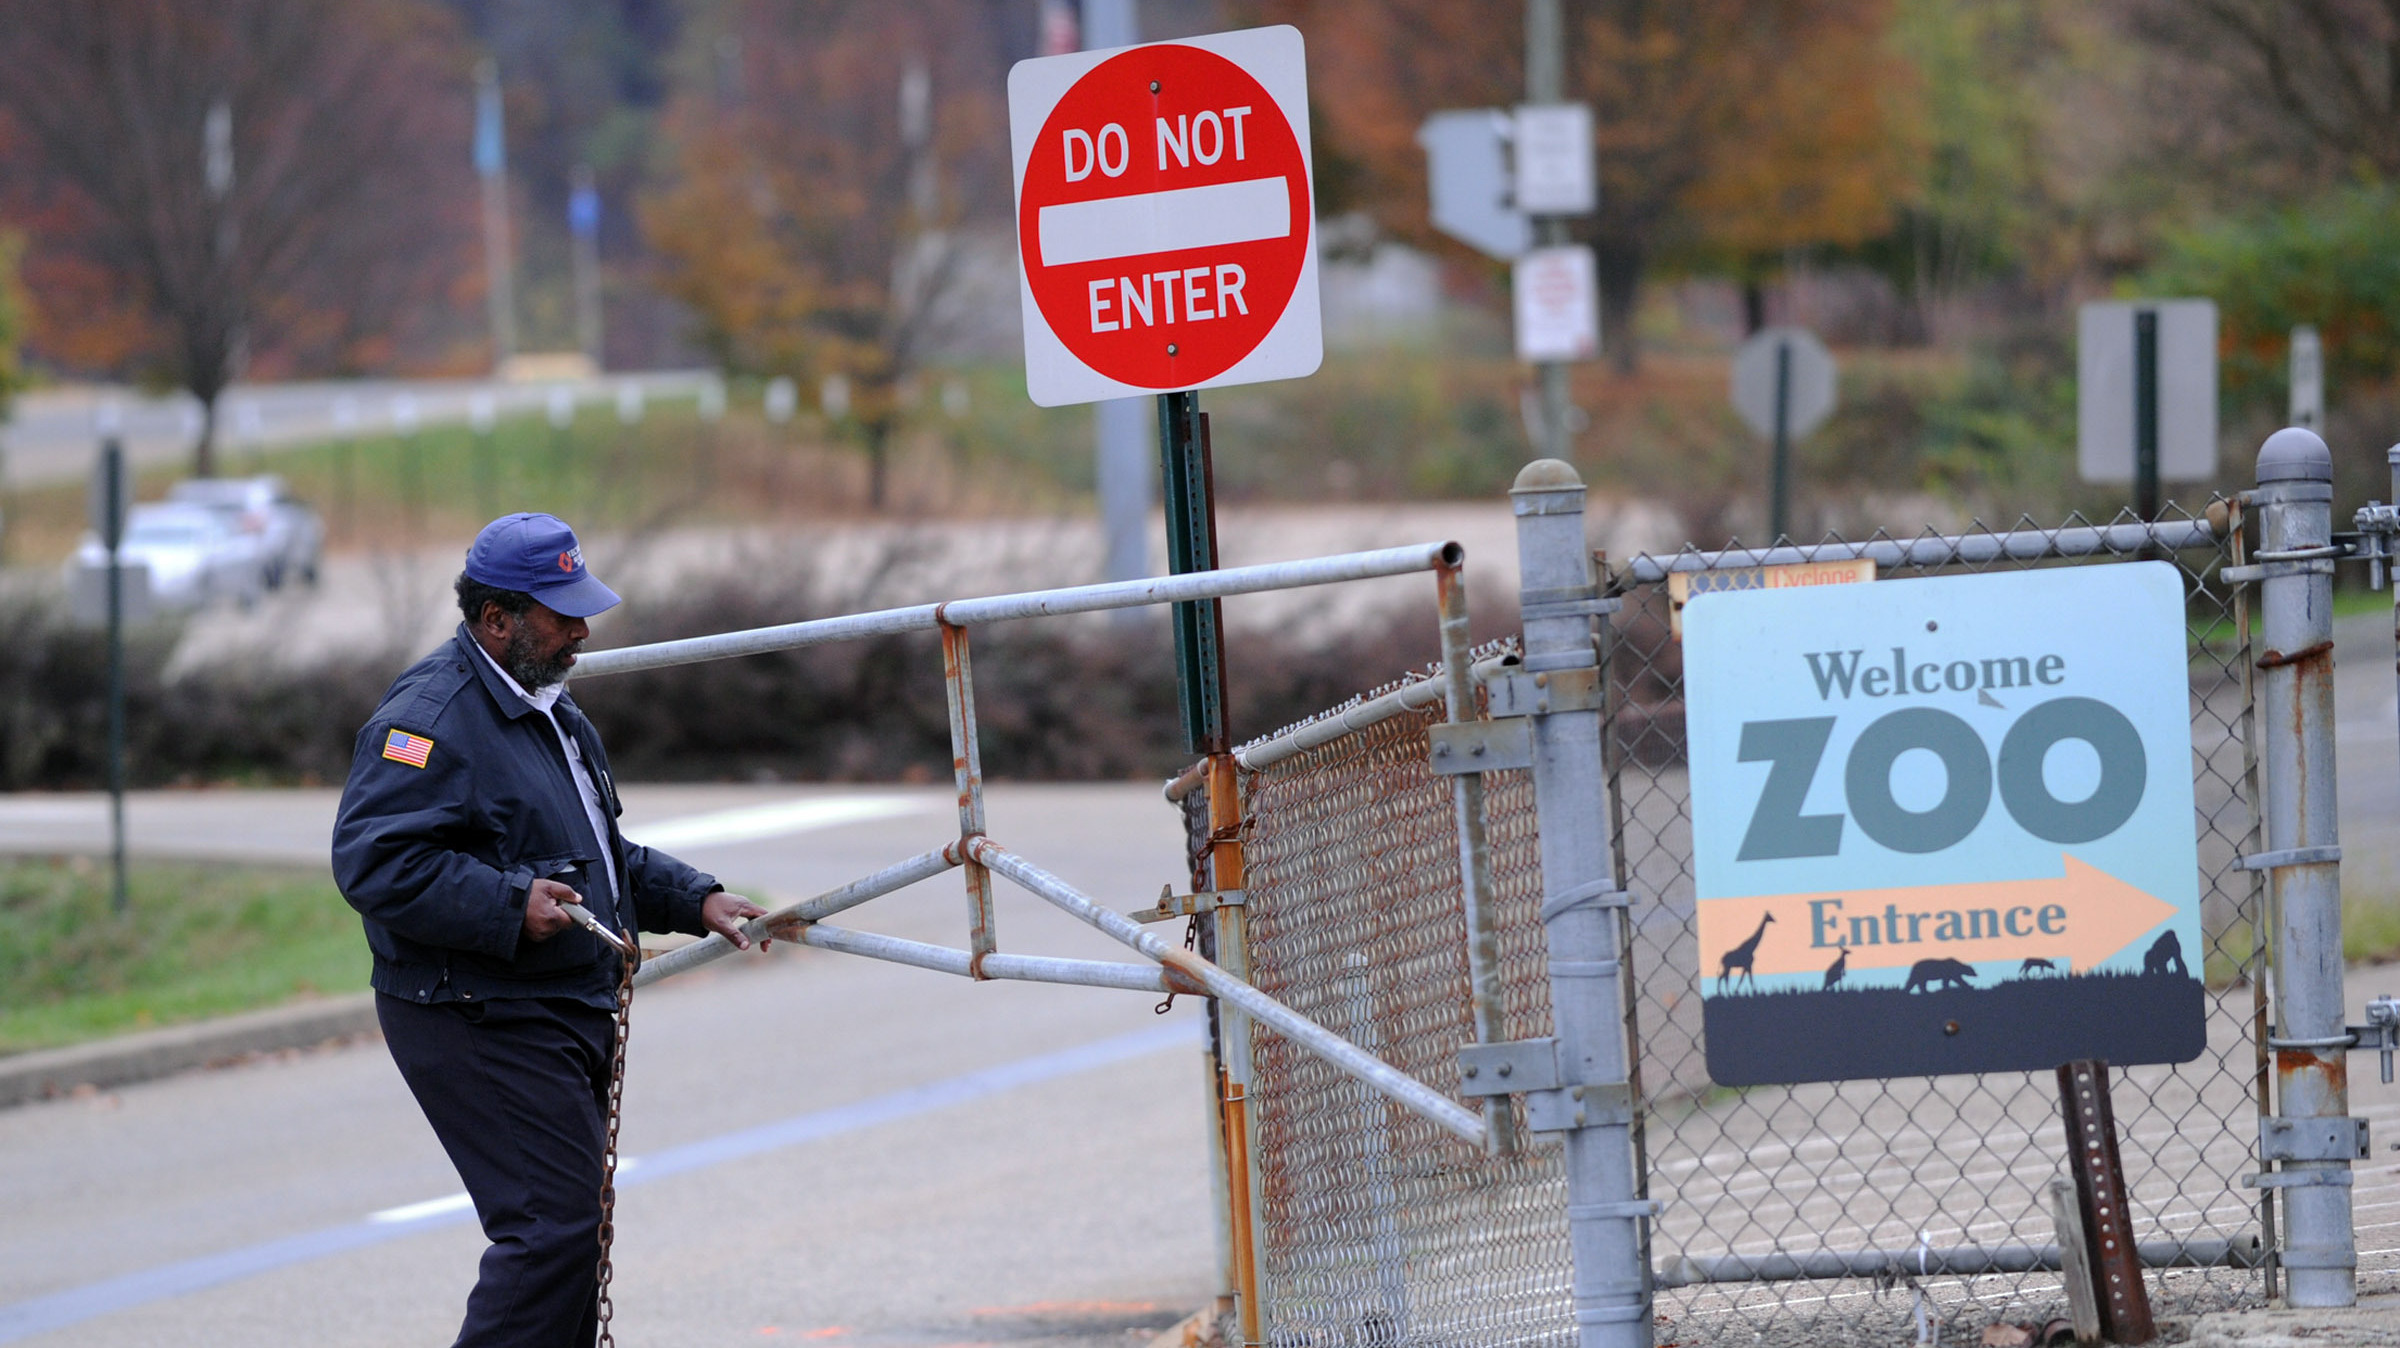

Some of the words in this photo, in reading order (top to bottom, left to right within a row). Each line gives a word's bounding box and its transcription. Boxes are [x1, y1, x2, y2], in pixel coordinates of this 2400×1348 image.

[1062, 122, 1130, 183] DO
[1155, 105, 1252, 171] NOT
[1087, 263, 1249, 334] ENTER
[1803, 647, 2066, 701] Welcome
[1735, 695, 2148, 862] ZOO
[1807, 898, 2067, 949] Entrance
